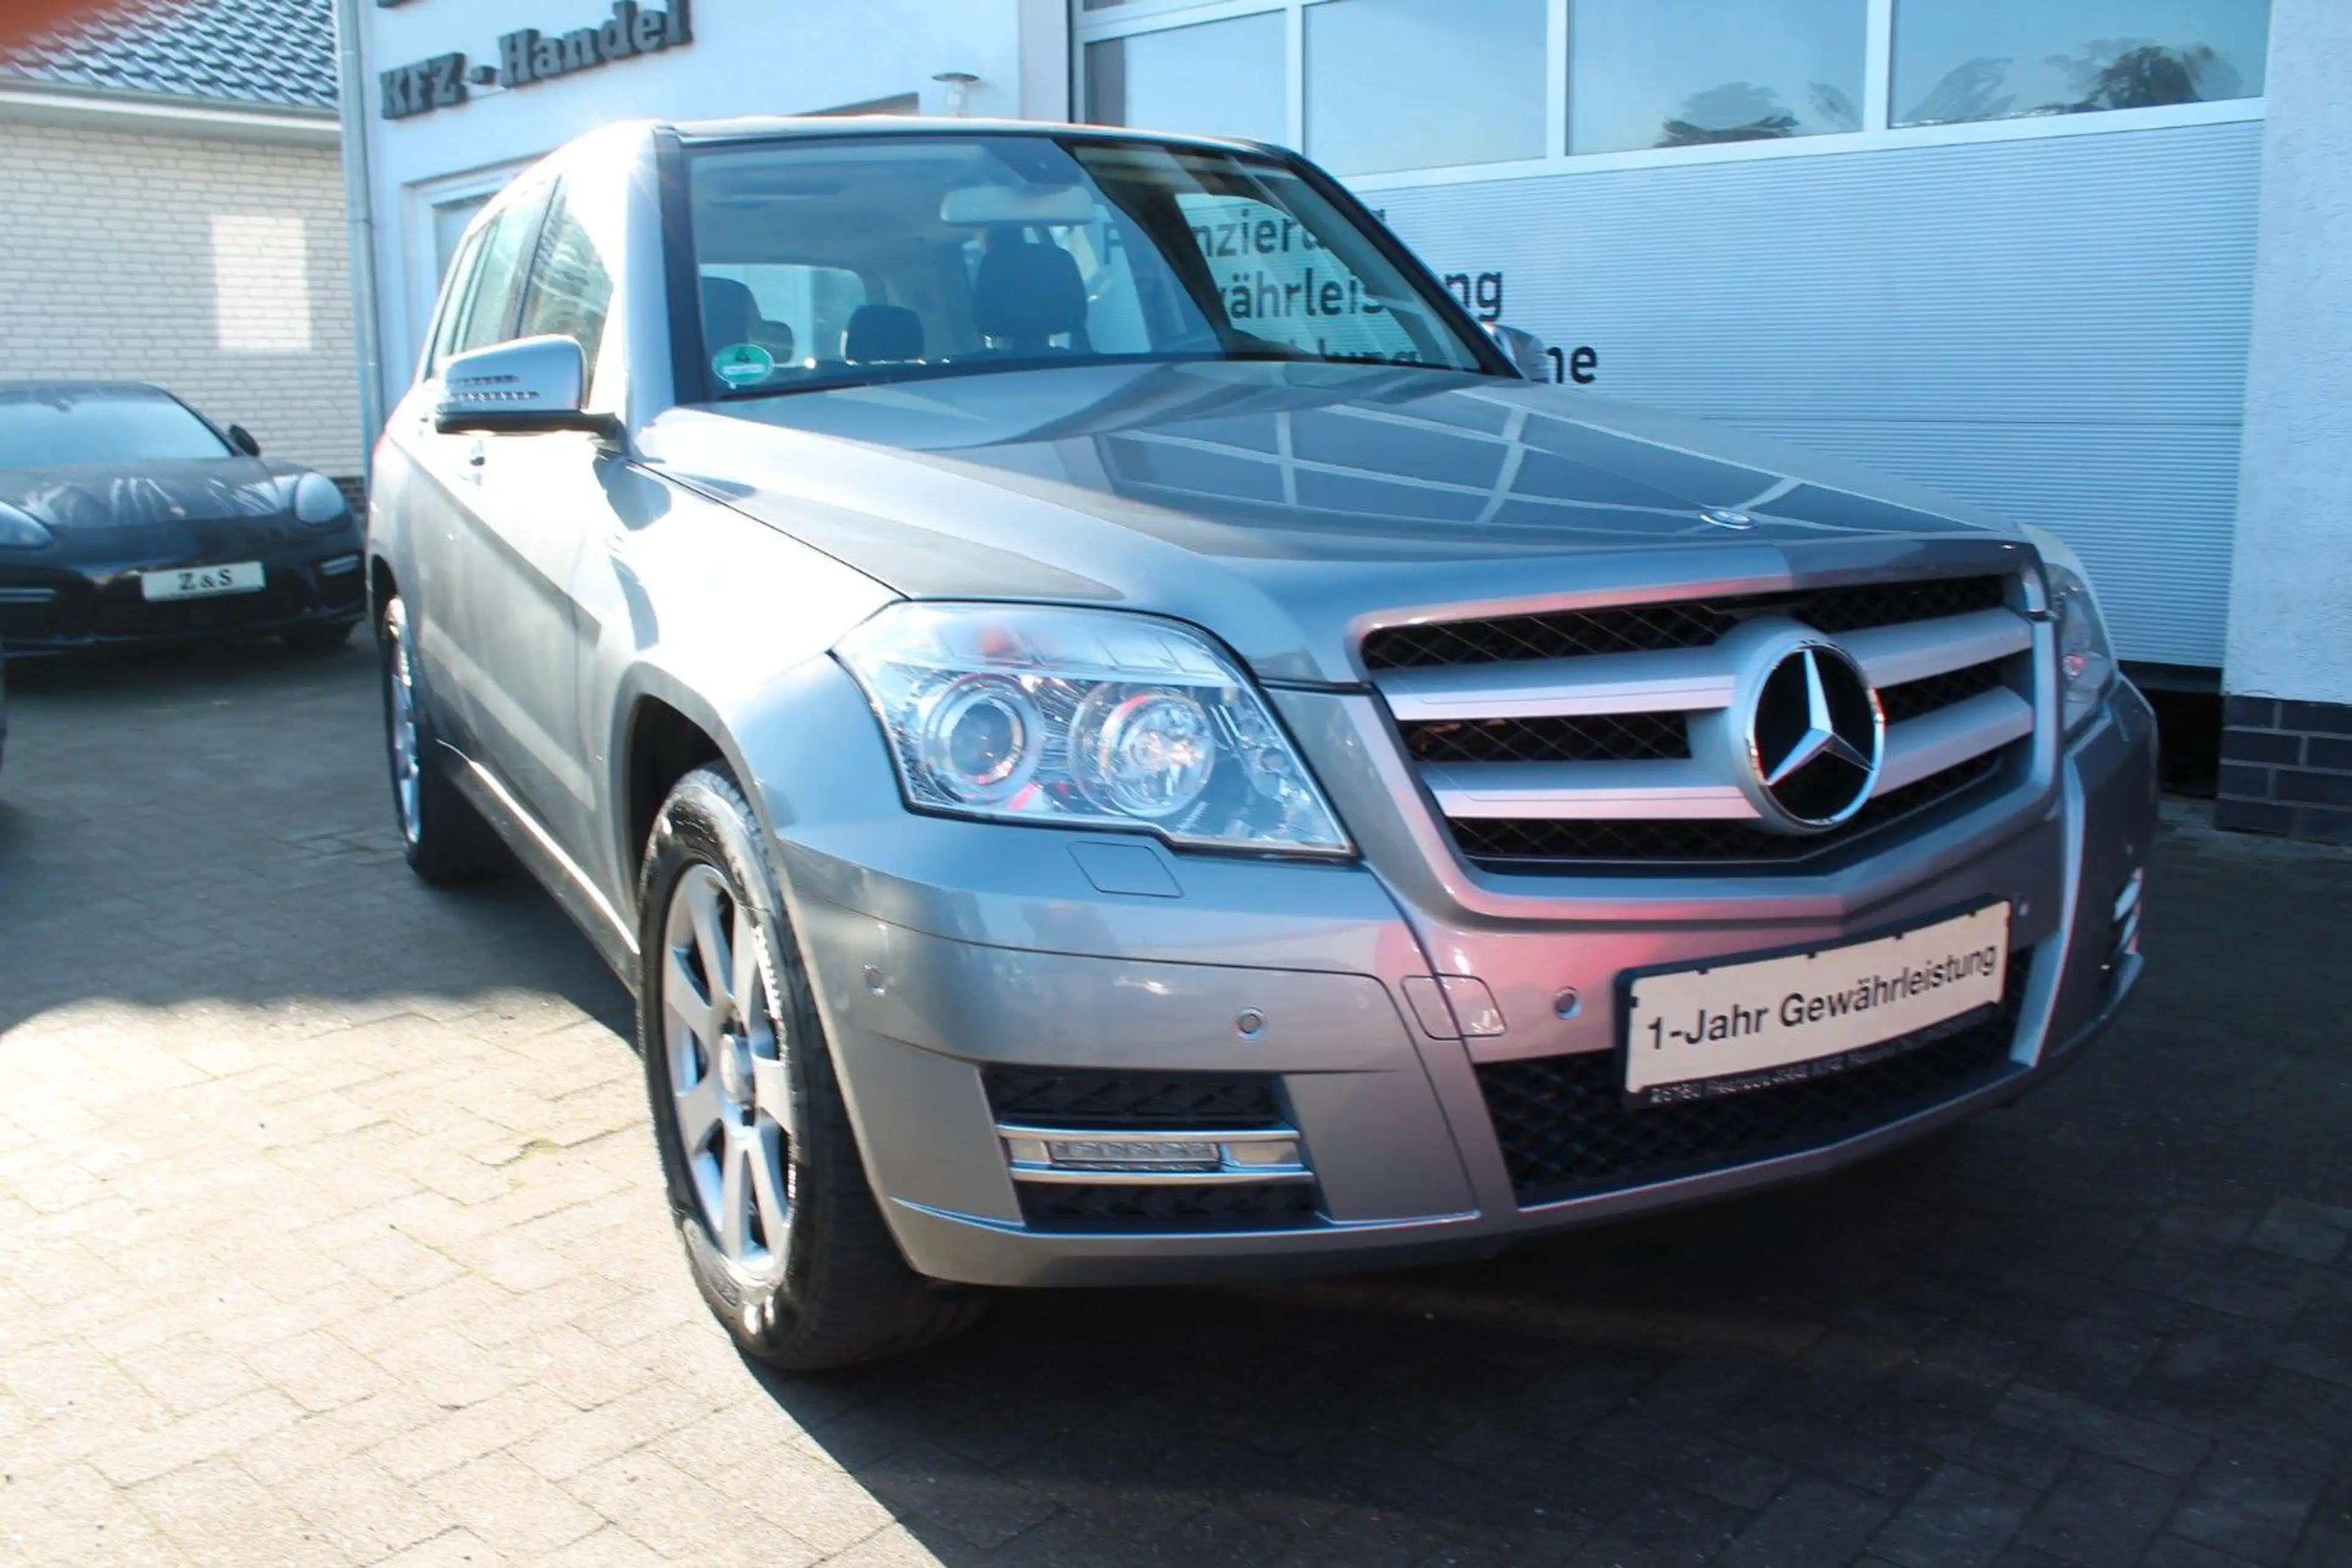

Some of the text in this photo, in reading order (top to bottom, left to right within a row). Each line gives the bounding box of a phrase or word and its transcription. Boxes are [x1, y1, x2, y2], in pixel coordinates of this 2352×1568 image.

[178, 572, 195, 590] Z
[217, 568, 233, 586] S
[1648, 944, 1996, 1050] 1-Jahr Gewährleistung
